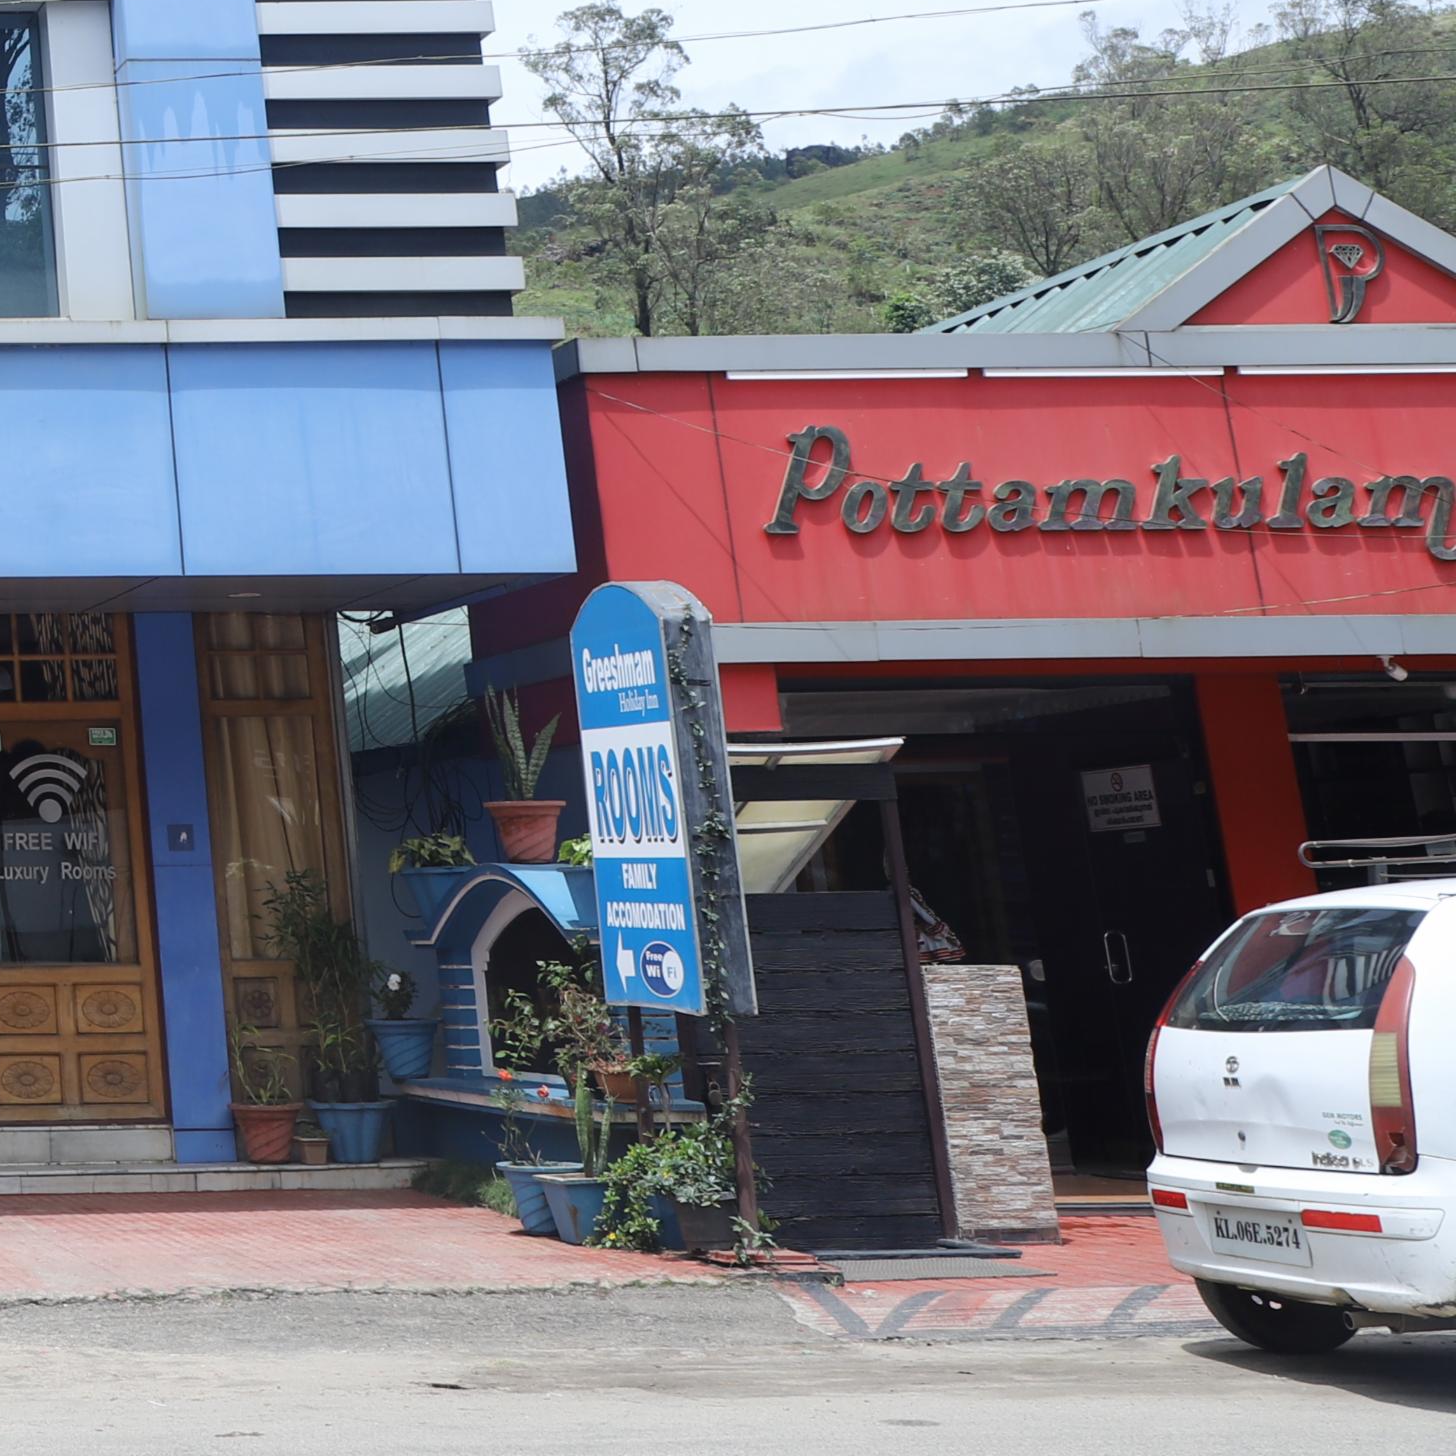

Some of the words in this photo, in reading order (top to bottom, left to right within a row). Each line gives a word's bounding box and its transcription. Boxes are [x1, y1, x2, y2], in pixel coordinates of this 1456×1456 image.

[763, 424, 1456, 561] Pottamkulam
[582, 643, 656, 694] Greeshmam
[618, 689, 645, 717] Holiday
[645, 688, 659, 710] Inn
[591, 744, 678, 843] ROOMS
[4, 832, 53, 850] FREE
[61, 862, 117, 880] Rooms
[621, 863, 657, 889] FAMILY
[607, 901, 686, 931] ACCOMODATION
[645, 951, 663, 962] Free
[1214, 1216, 1301, 1250] KL.06E.5274
